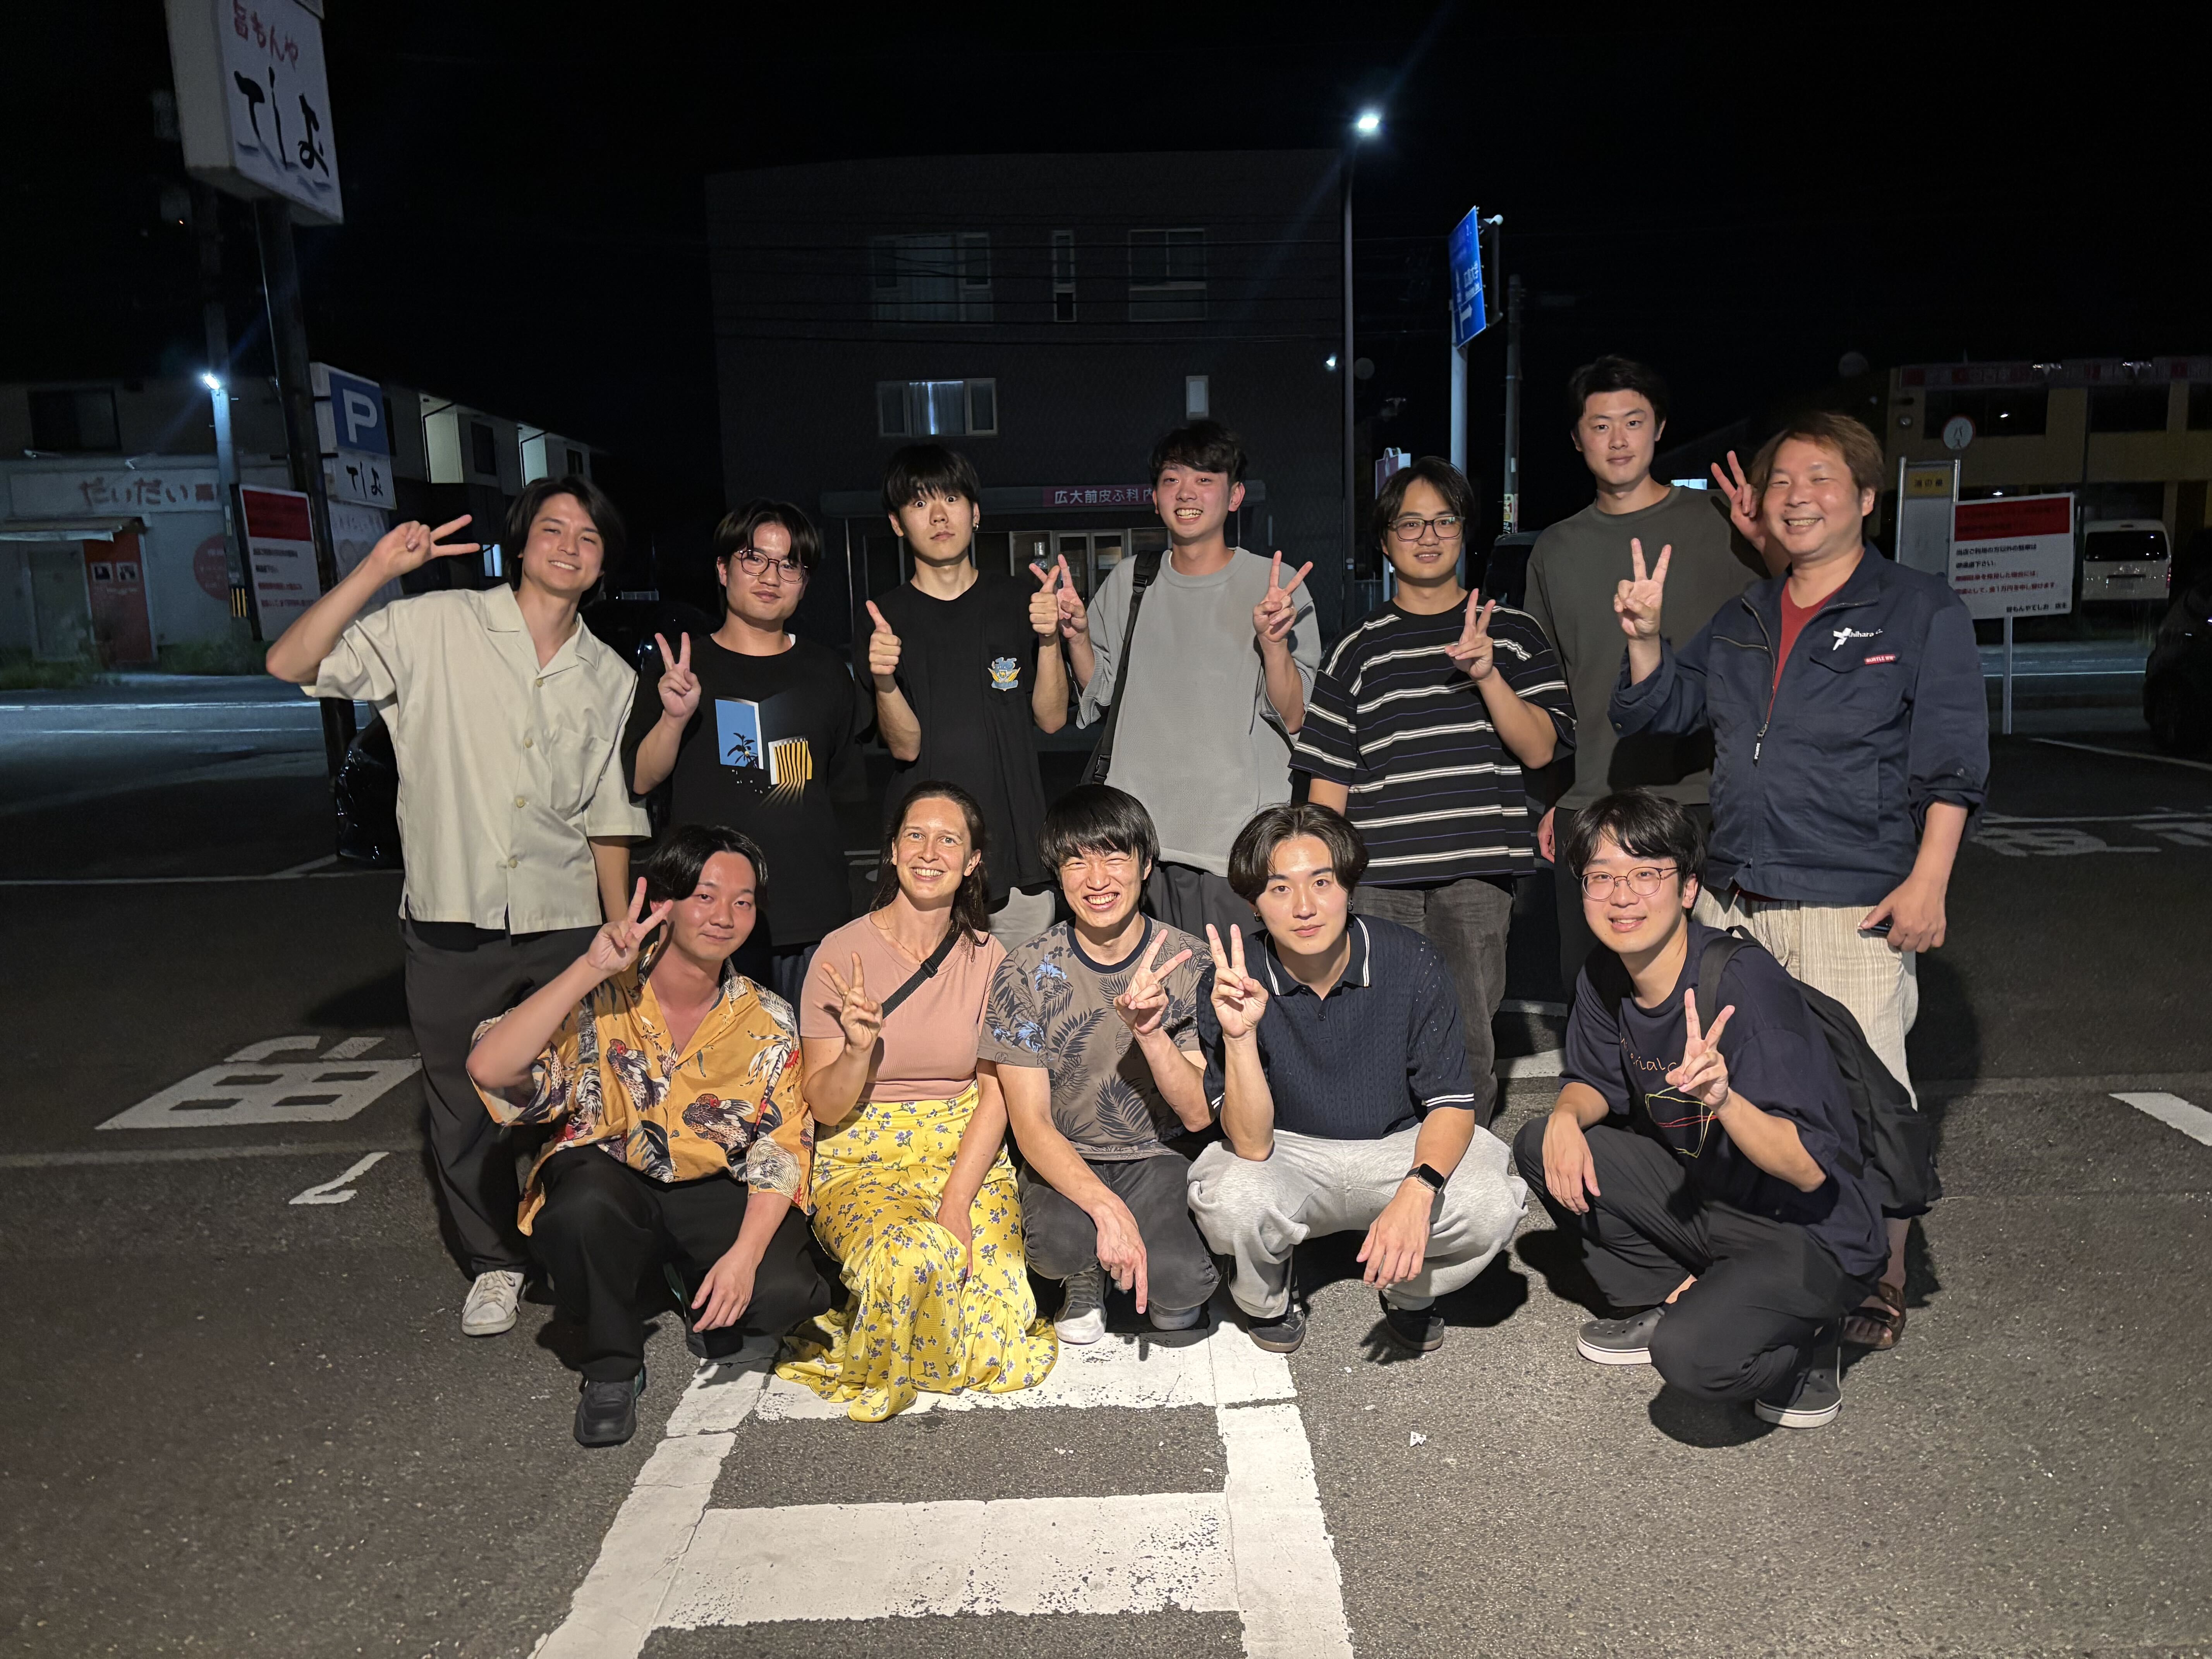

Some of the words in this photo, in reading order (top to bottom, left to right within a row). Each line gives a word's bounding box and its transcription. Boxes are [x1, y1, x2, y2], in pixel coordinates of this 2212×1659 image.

[343, 389, 378, 443] P
[1054, 488, 1139, 505] 広大前皮ふ科
